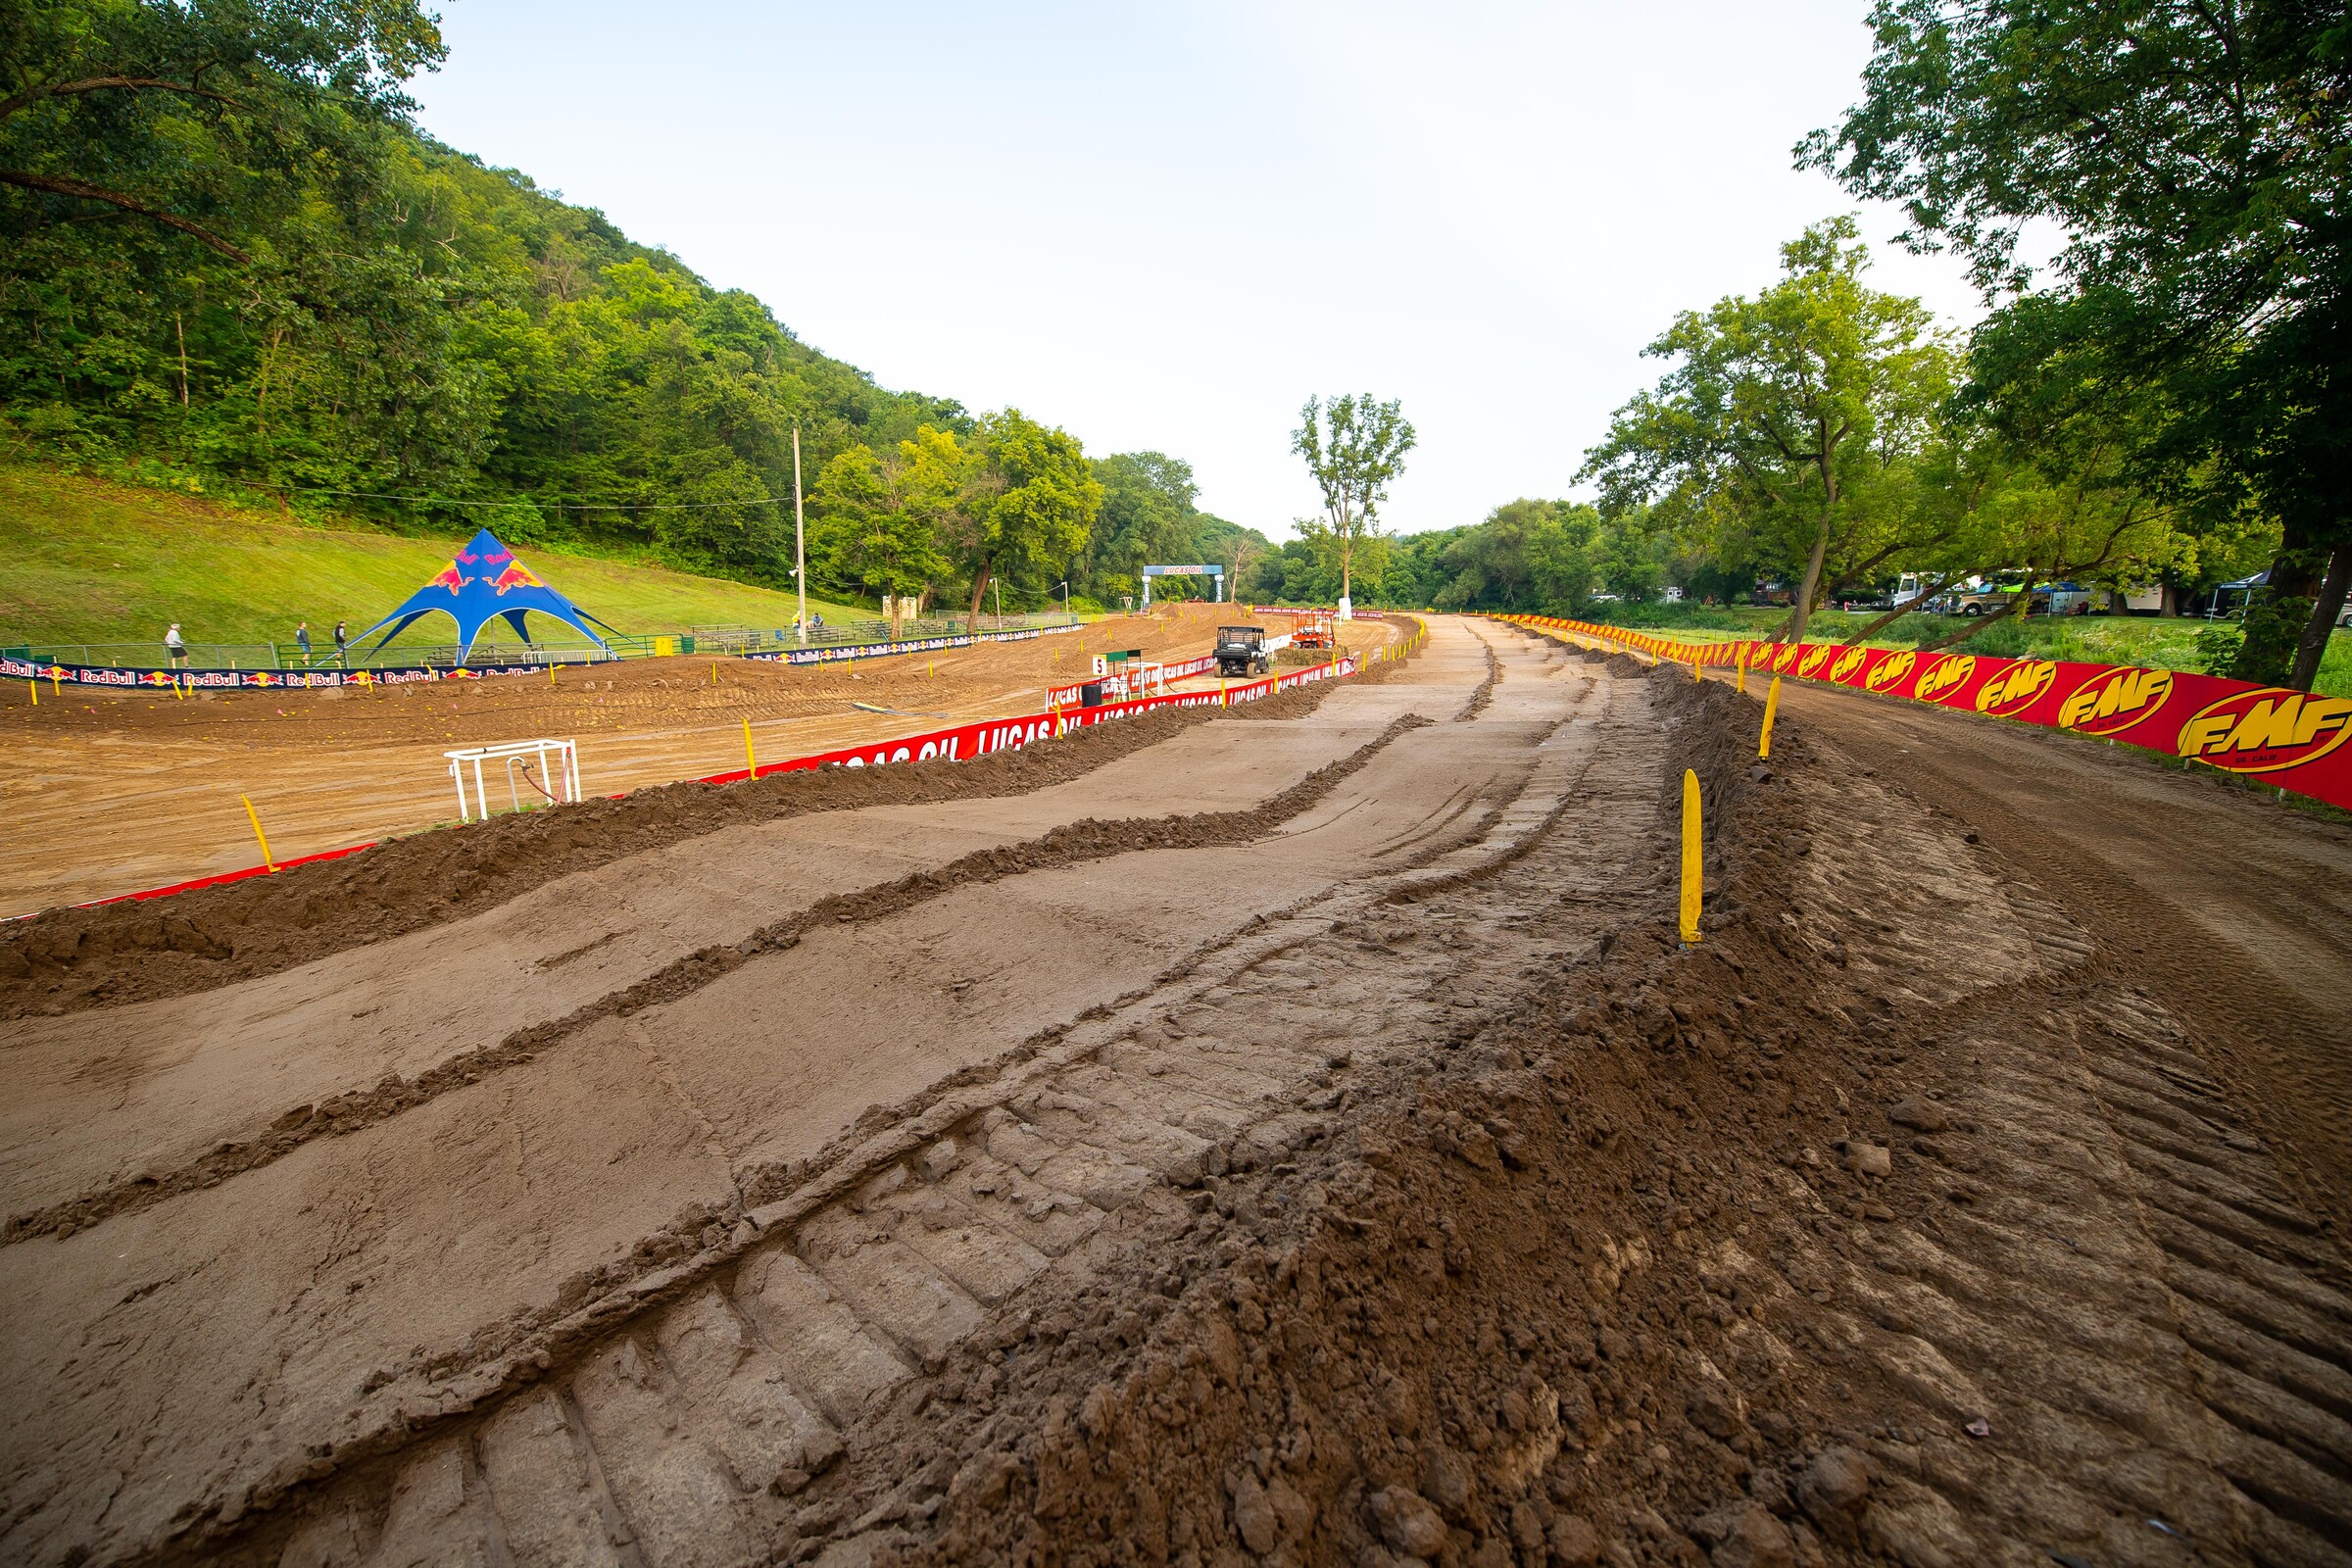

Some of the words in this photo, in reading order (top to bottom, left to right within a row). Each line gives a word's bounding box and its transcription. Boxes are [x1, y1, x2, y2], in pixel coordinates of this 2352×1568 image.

[1098, 659, 1102, 673] 5
[1798, 645, 1831, 677] FMF
[1831, 647, 1867, 682] FMF
[1866, 652, 1916, 690] FMF
[1915, 656, 1976, 700] FMF
[1977, 662, 2056, 713] FMF
[2059, 669, 2172, 729] FMF
[2178, 693, 2352, 758] FMF
